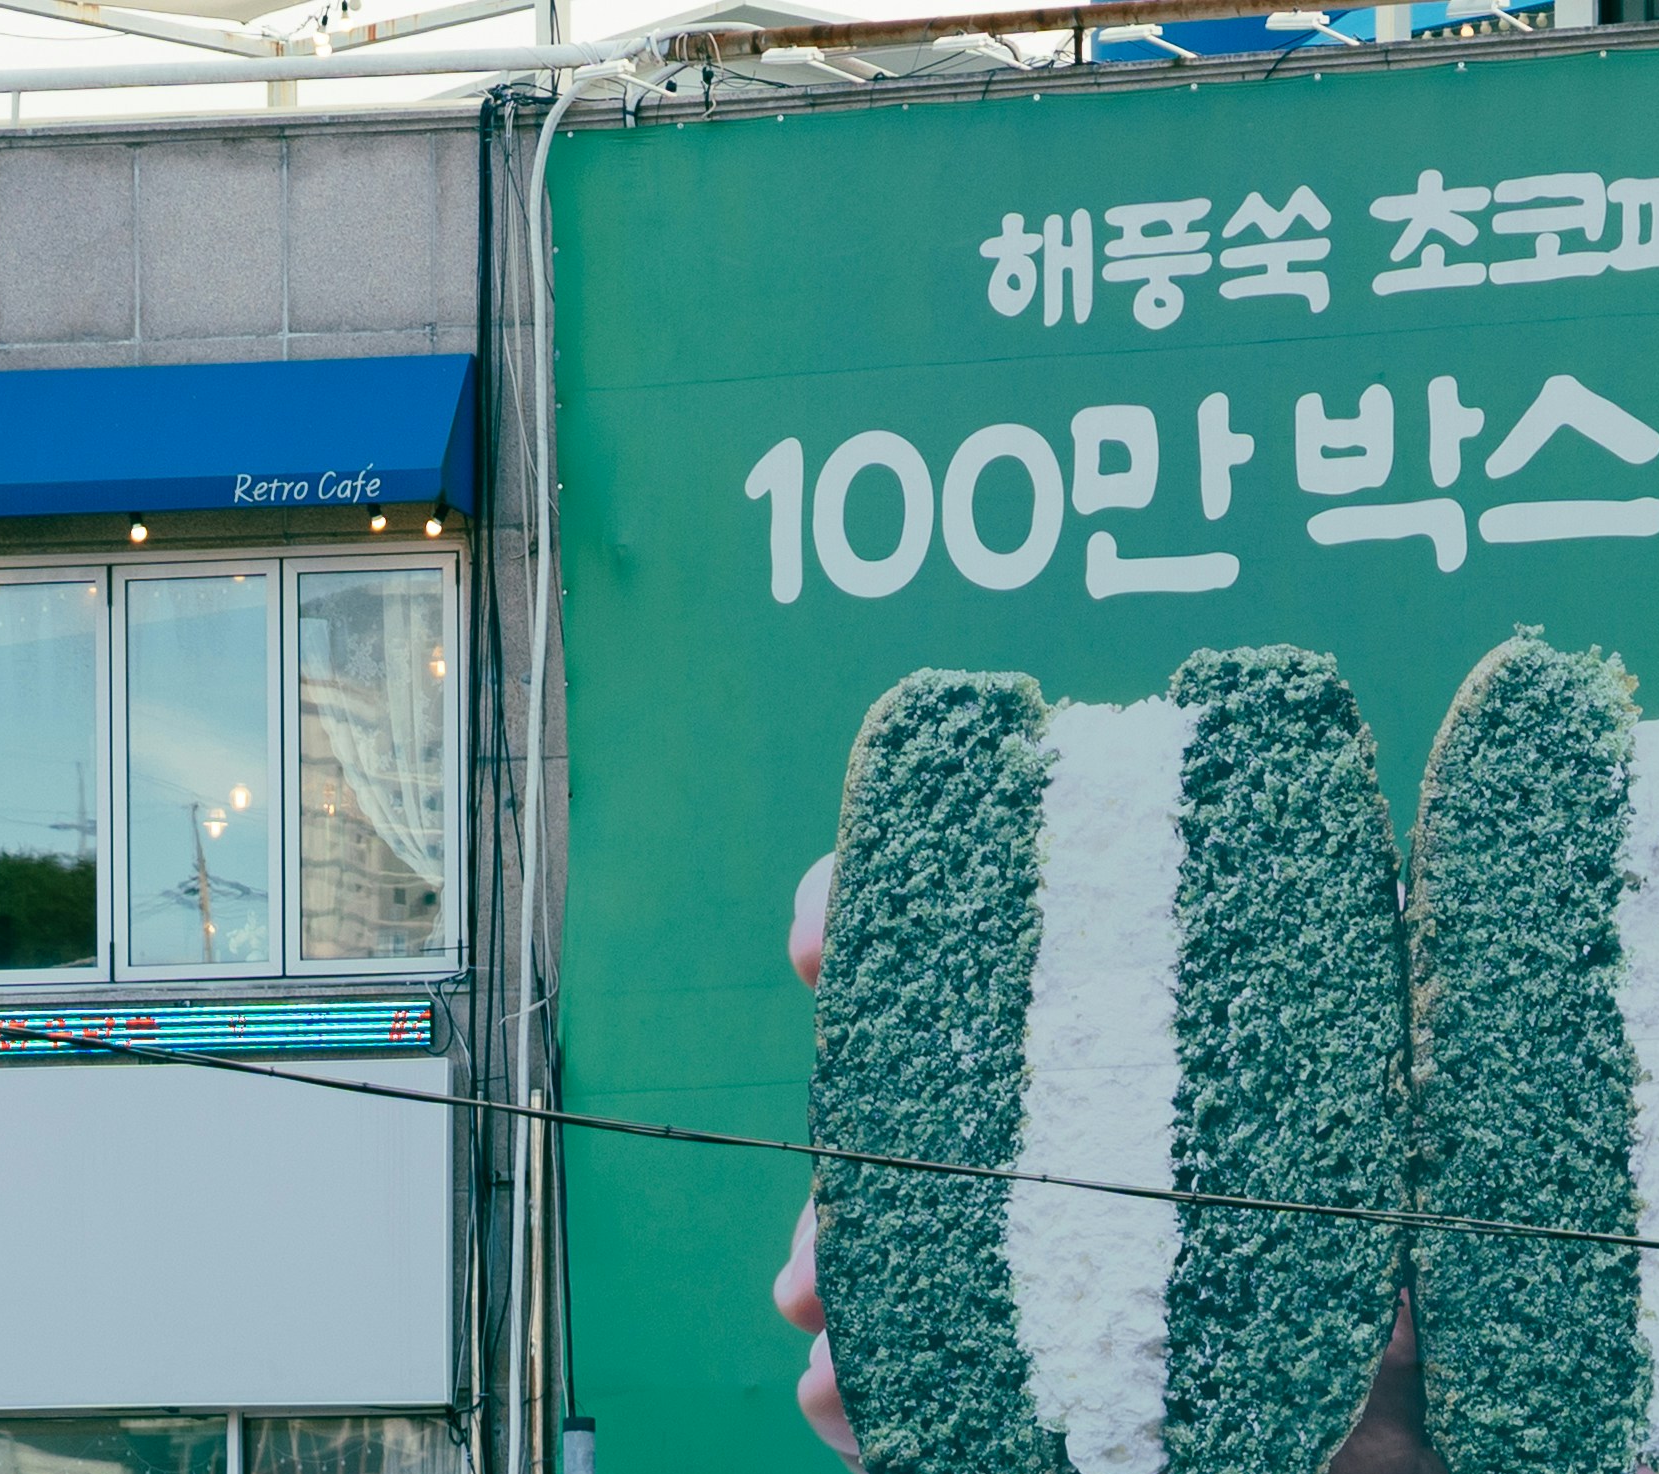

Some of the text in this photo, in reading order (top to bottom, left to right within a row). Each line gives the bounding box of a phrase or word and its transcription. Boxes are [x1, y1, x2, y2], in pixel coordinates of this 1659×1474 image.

[980, 182, 1333, 332] 해풍쑥
[233, 463, 381, 503] Retro Café
[743, 389, 1241, 606] 100만
